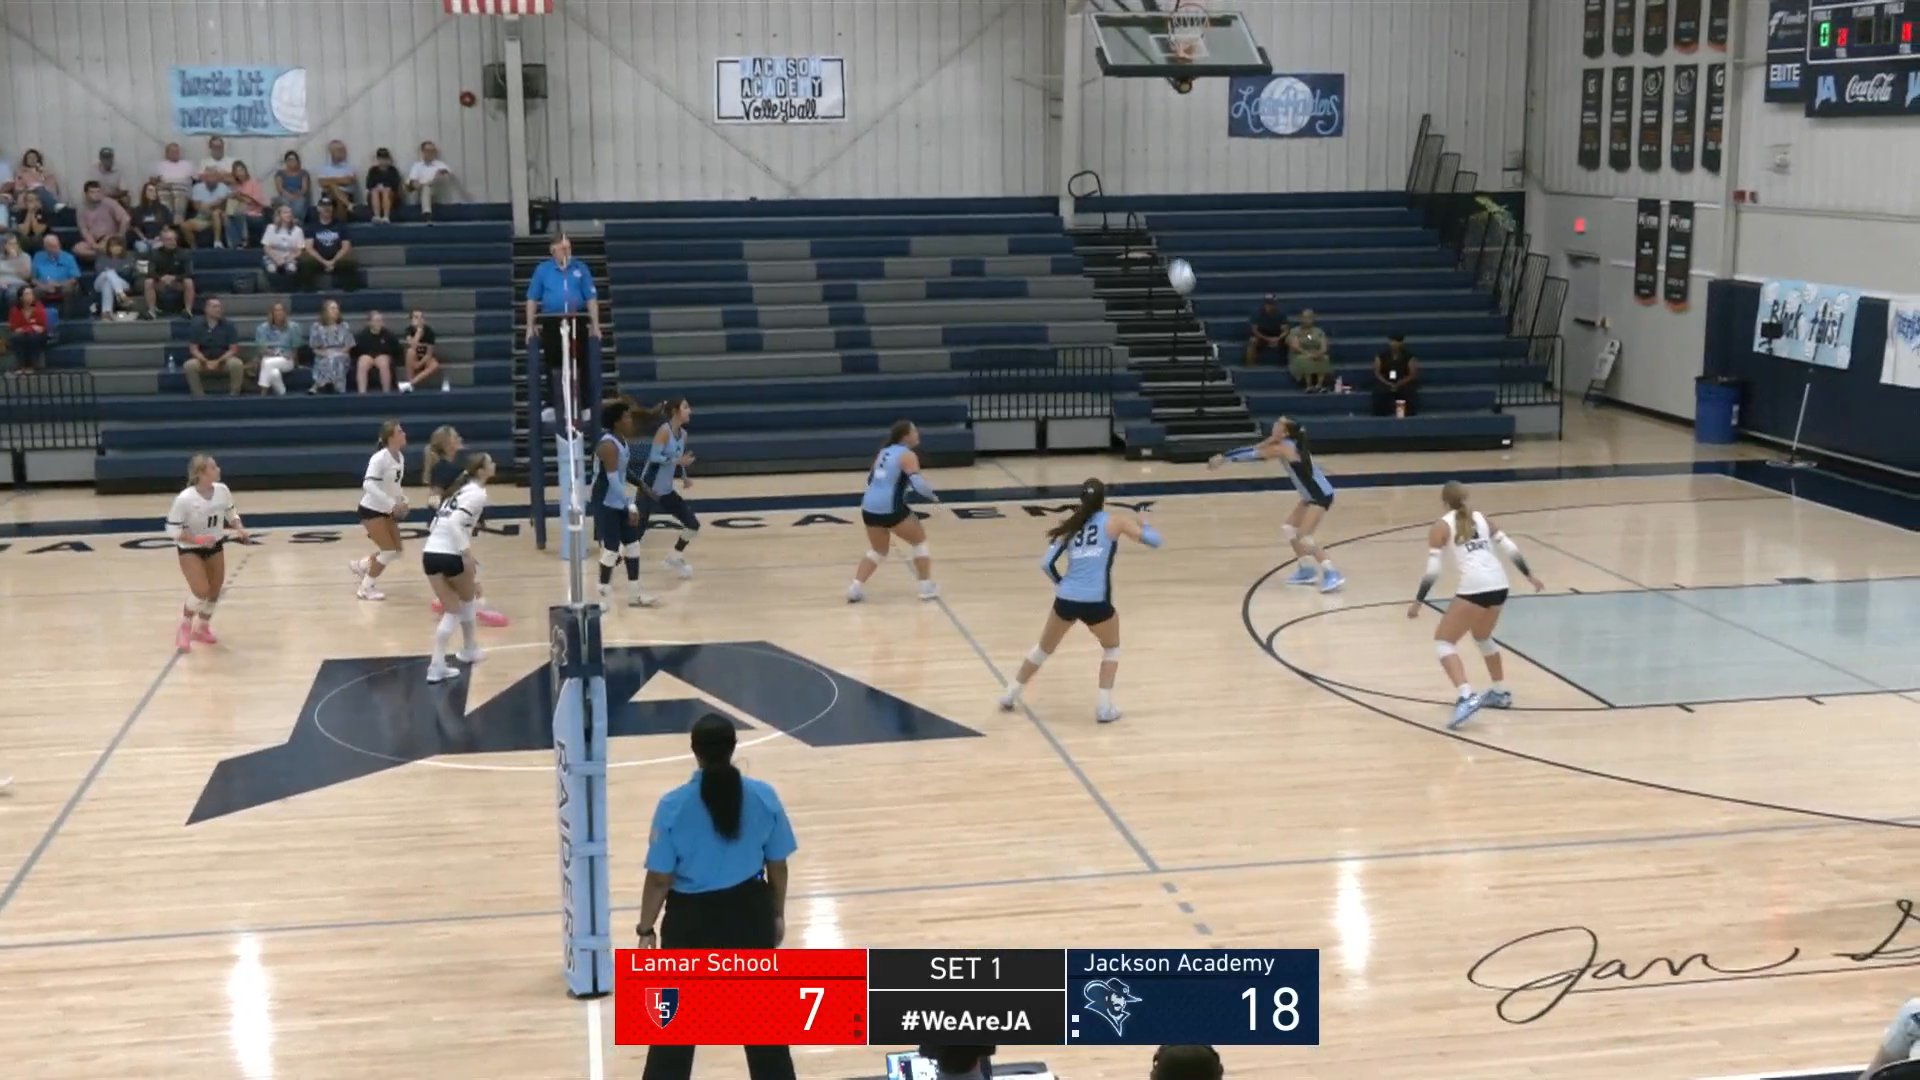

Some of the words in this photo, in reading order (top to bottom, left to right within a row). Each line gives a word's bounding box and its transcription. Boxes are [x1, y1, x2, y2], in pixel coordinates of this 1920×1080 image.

[741, 57, 821, 77] JACKSON
[741, 77, 822, 98] ACADEMY
[741, 98, 819, 123] Volleyball
[207, 514, 218, 528] 11
[1073, 524, 1099, 547] 32
